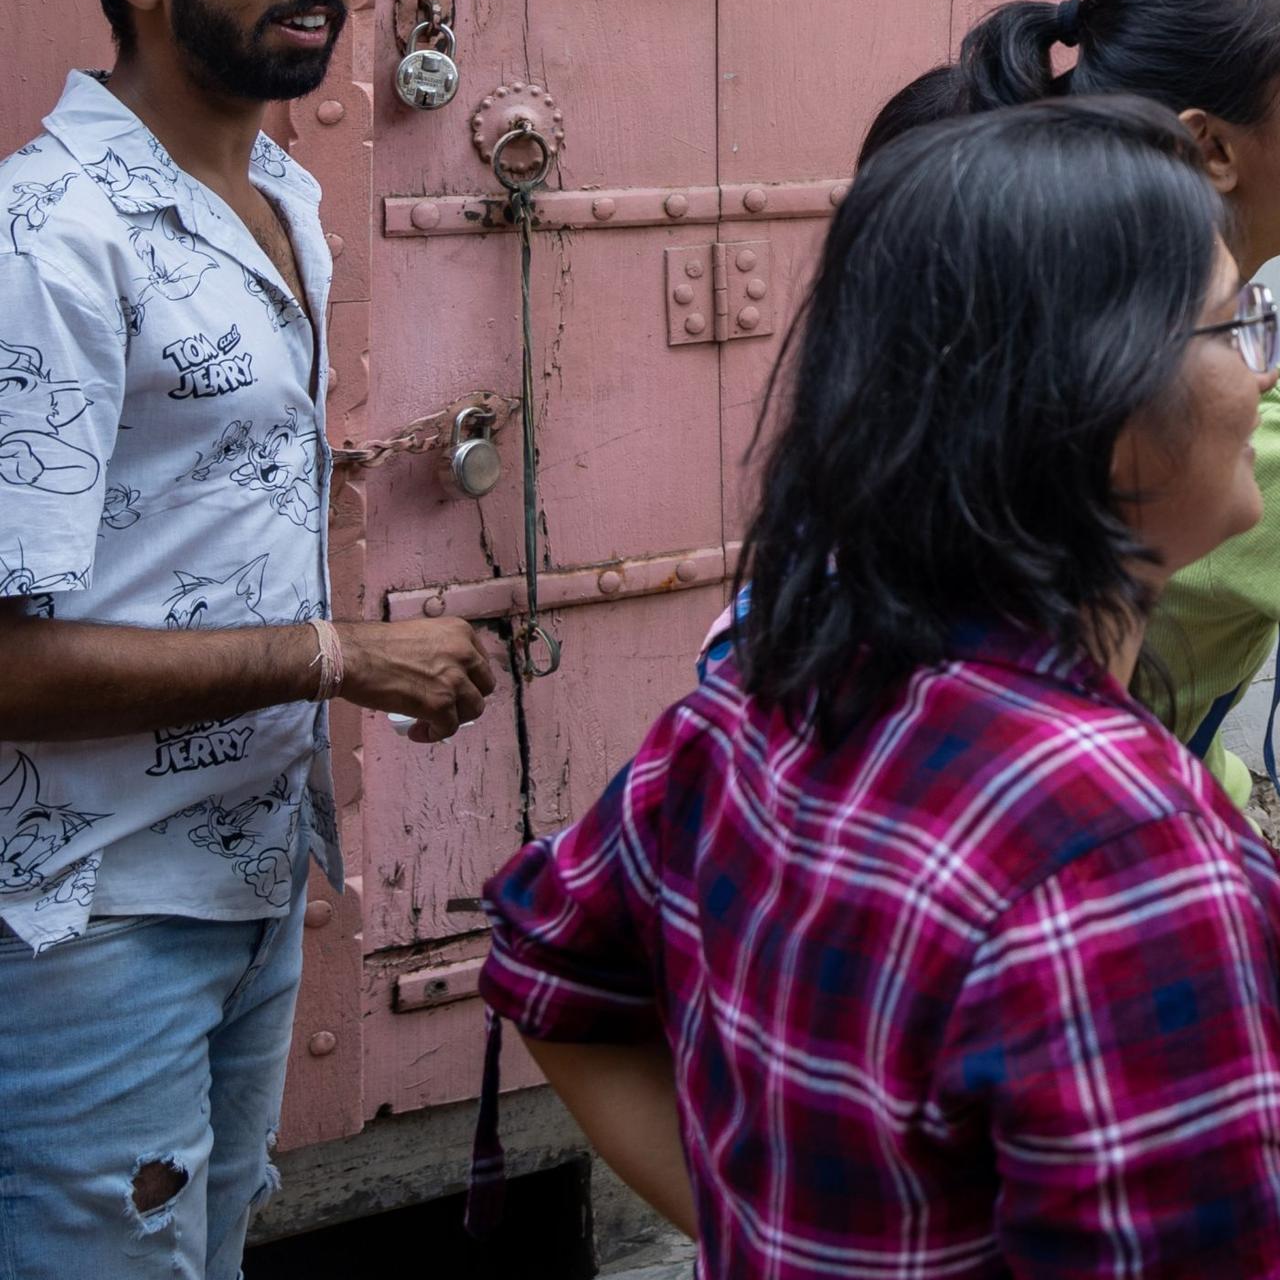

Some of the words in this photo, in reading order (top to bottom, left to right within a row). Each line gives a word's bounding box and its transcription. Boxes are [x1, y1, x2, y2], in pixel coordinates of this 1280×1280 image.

[163, 333, 219, 372] TOM
[217, 324, 241, 355] and
[168, 353, 253, 400] JERRY
[146, 726, 254, 777] JERRY
